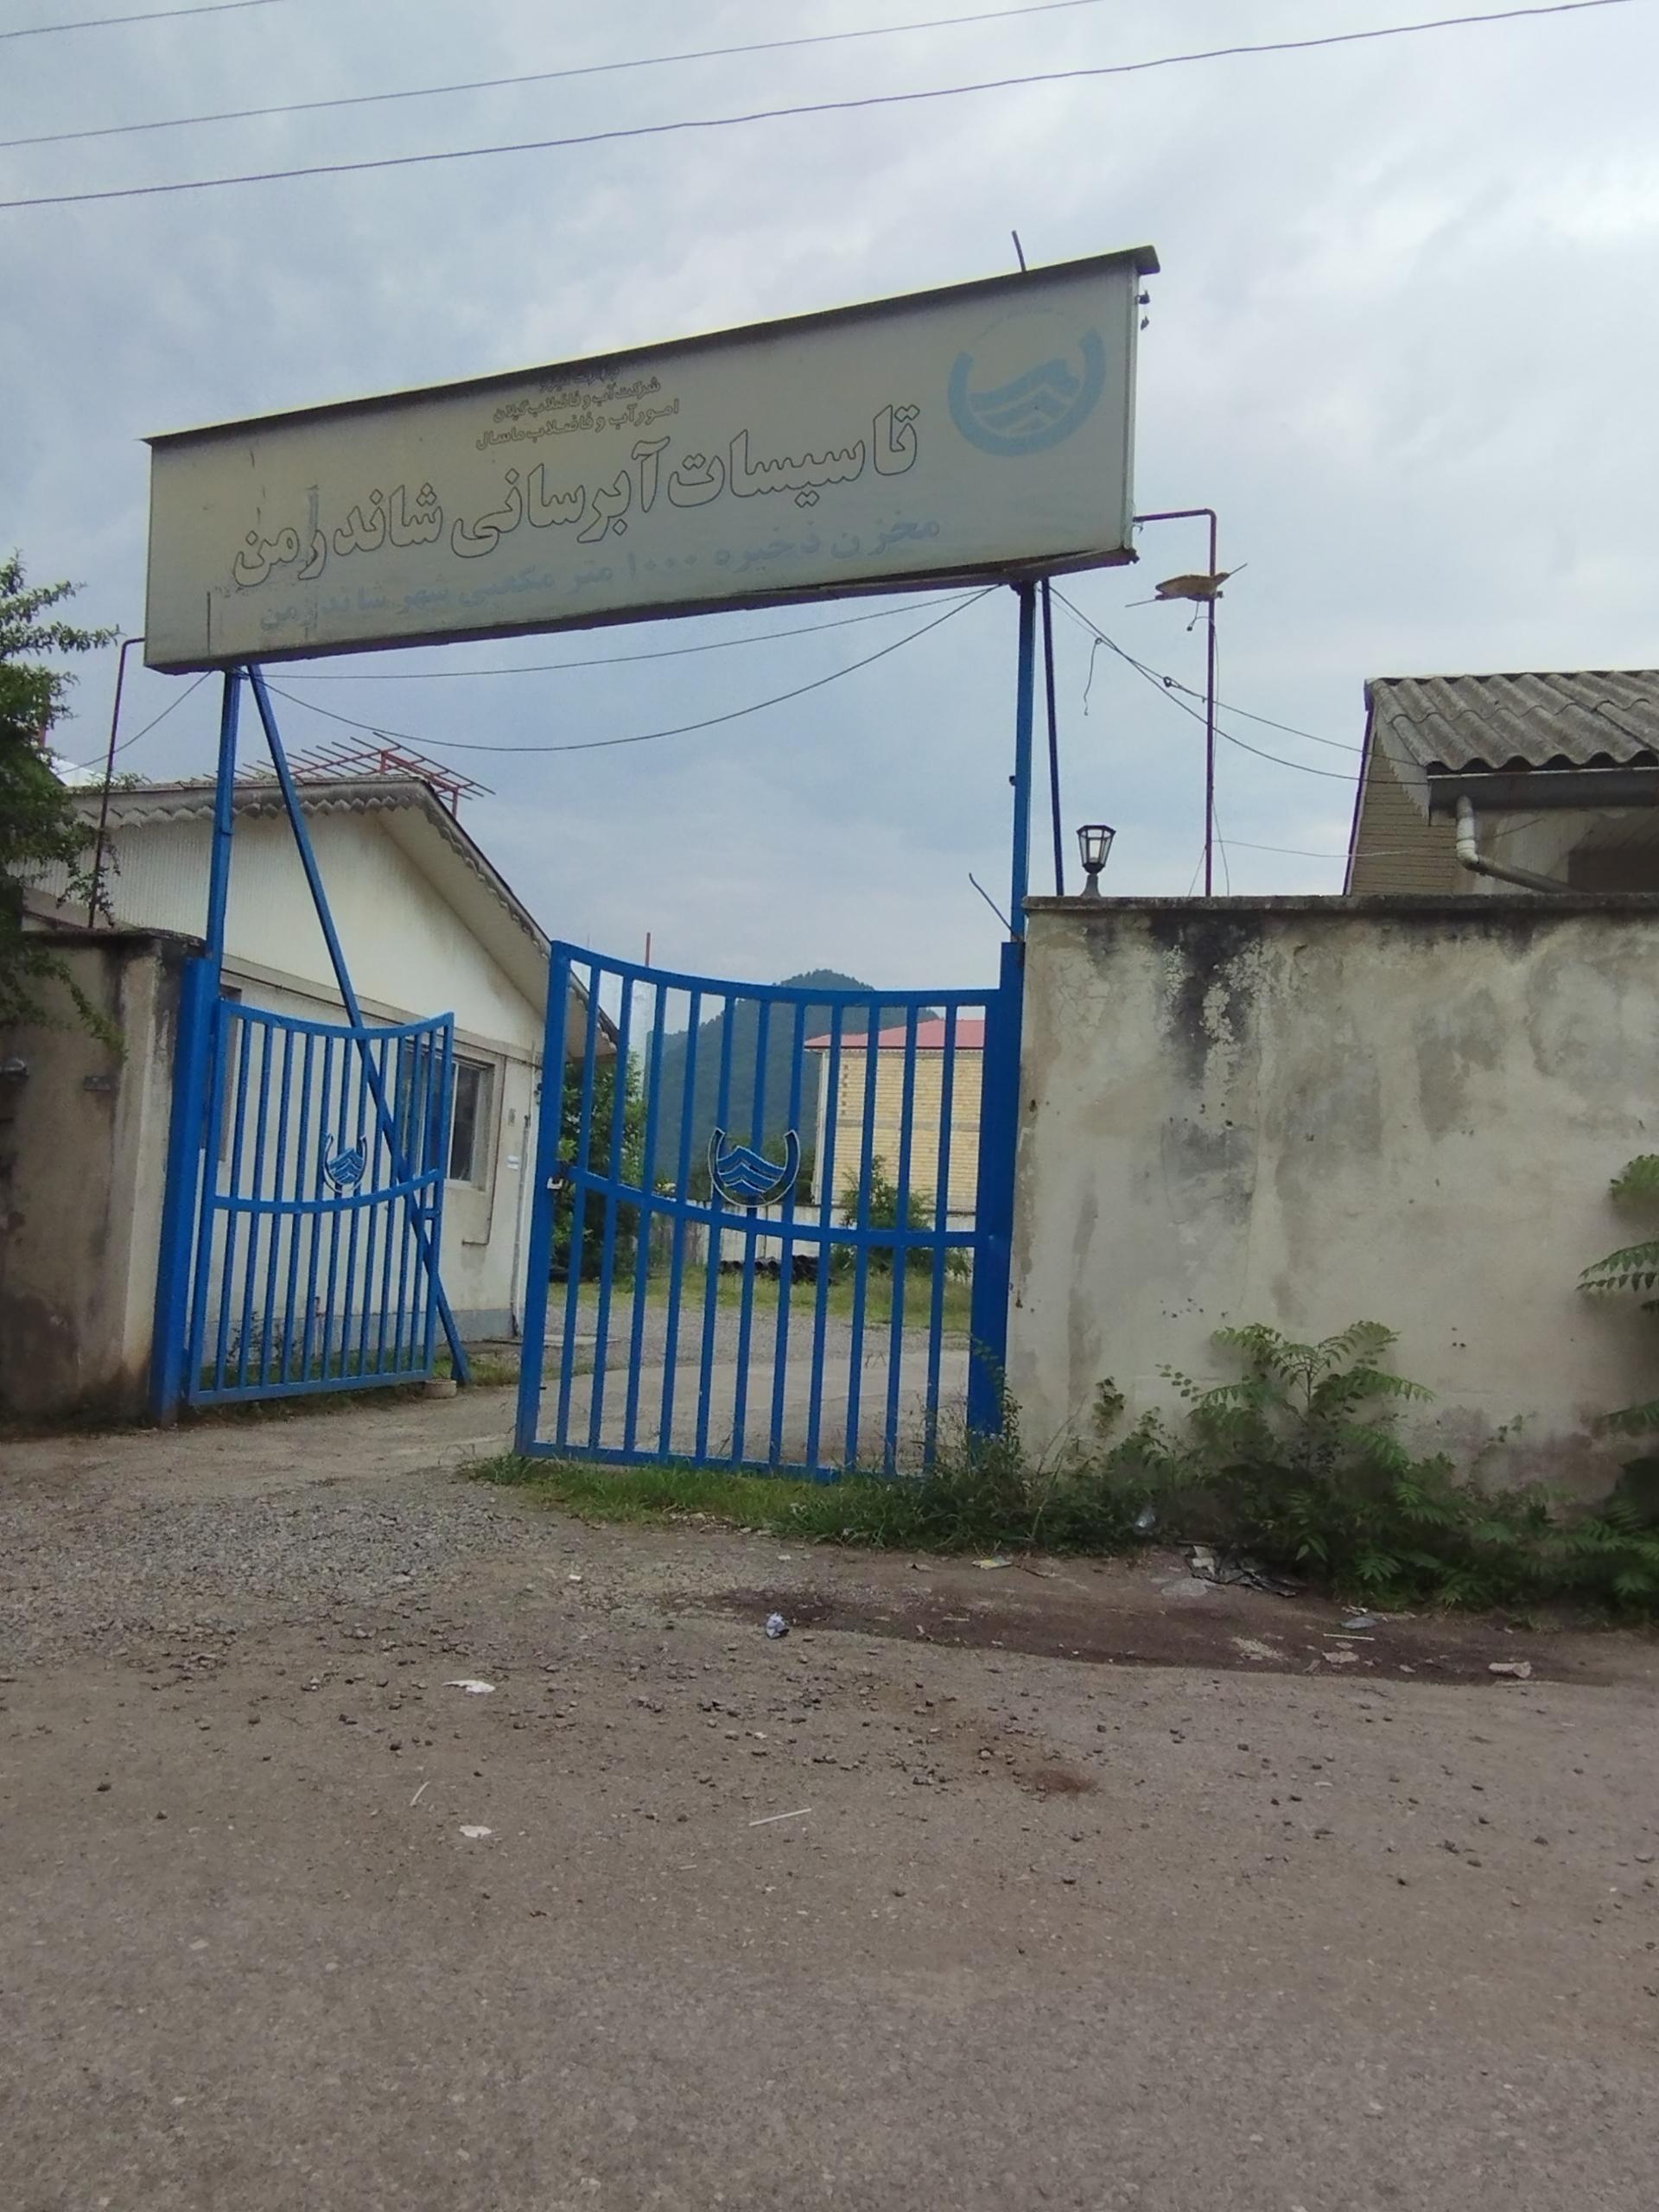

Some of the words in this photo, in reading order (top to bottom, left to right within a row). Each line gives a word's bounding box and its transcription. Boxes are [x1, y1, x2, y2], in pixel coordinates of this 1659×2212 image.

[581, 394, 592, 410] و
[592, 381, 616, 407] آب
[594, 416, 606, 434] و
[607, 403, 638, 430] آب
[634, 398, 680, 427] امور
[475, 427, 526, 451] ماسال
[525, 410, 594, 443] فاضلاب
[667, 404, 921, 509] تاسیسات
[450, 435, 671, 558] آبرسانی
